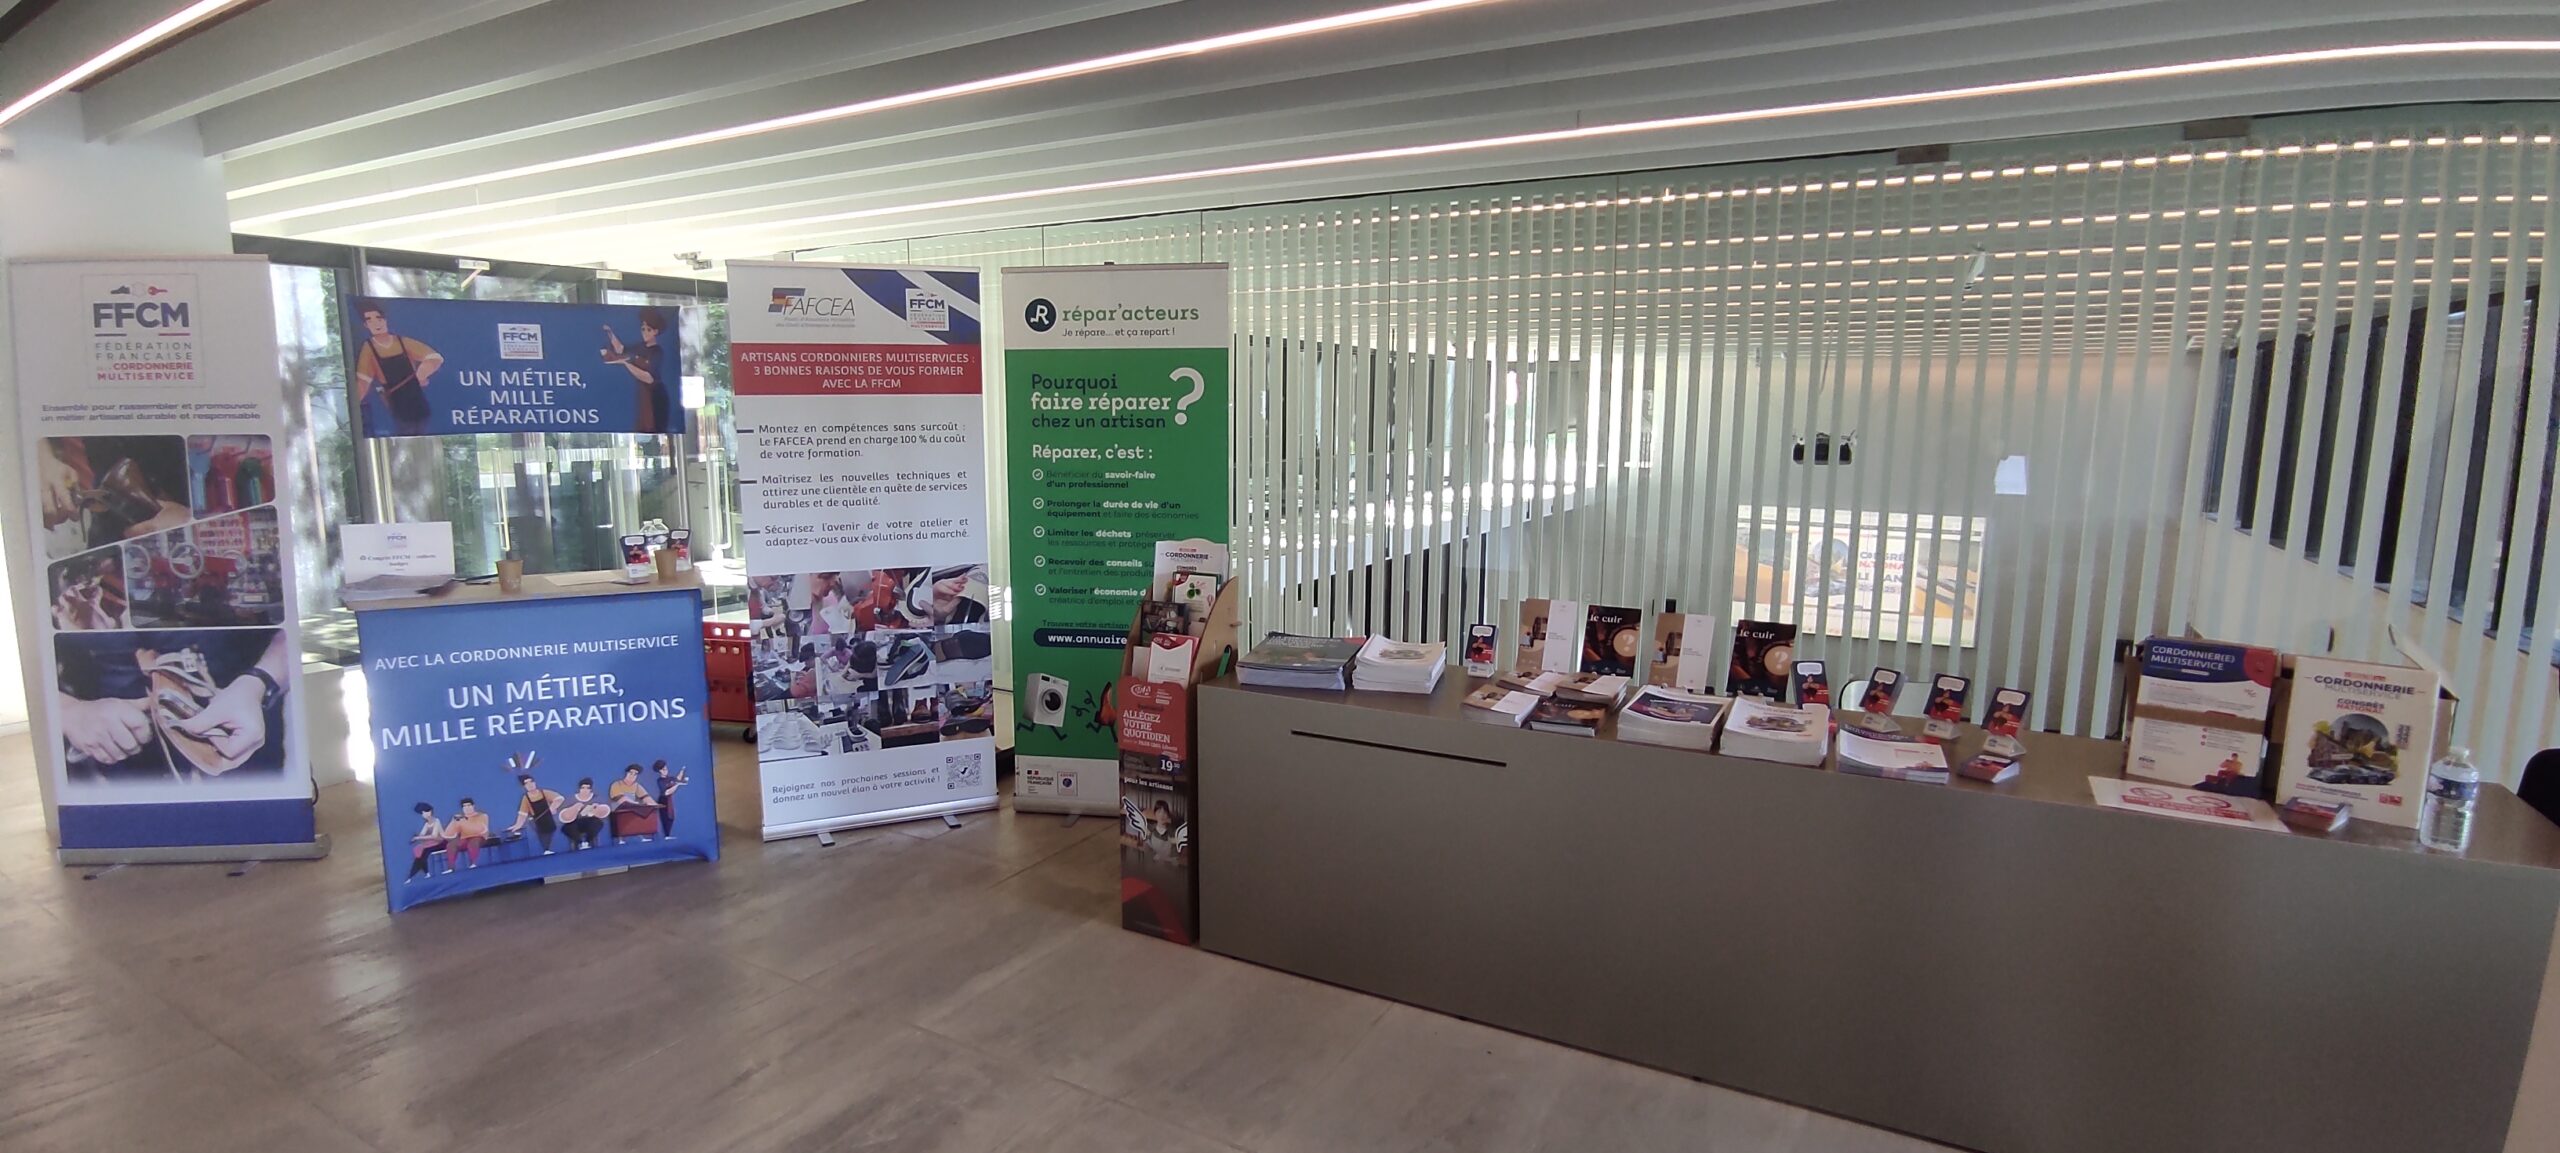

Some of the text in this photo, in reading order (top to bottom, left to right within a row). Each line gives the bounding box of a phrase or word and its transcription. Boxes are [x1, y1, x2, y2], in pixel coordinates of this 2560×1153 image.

[783, 297, 855, 317] FAFCEA
[909, 299, 945, 309] FFCM
[93, 303, 189, 328] FFCM
[1062, 304, 1199, 327] répar'acteurs
[503, 332, 538, 341] FFCM
[1075, 327, 1113, 338] répare...
[1115, 328, 1124, 336] et
[1127, 329, 1138, 338] ça
[1140, 328, 1169, 338] repart
[95, 342, 192, 350] FÉDÉRATION
[96, 352, 193, 360] FRANÇAISE
[741, 353, 969, 363] ARTISANS CORDONNIERS MULTISERVICES
[113, 362, 193, 370] CORDONNERIE
[754, 366, 963, 376] 3 BONNES RAISONS DE VOUS FORMER
[97, 372, 194, 380] MULTISERVICE
[459, 368, 587, 389] UN MÉTIER,
[823, 379, 901, 388] AVEC LA FFCM
[1032, 373, 1118, 394] Pourquoi
[491, 390, 554, 406] MILLE
[1031, 367, 1204, 425] faire réparer ?
[92, 404, 115, 412] pour
[195, 403, 257, 411] promouvoir
[57, 413, 85, 421] métier
[137, 412, 176, 420] durable
[193, 412, 260, 421] responsable
[452, 406, 600, 425] RÉPARATIONS
[1032, 414, 1166, 428] chez un artisan
[759, 424, 798, 434] Montez
[822, 423, 888, 434] compétences
[921, 422, 958, 431] surcoût
[760, 434, 966, 448] Le FAFCEA prend en charge 100 % du coût
[760, 448, 863, 460] de votre formation.
[1032, 443, 1144, 463] Réparer, c'est
[762, 471, 967, 484] Maîtrisez les nouvelles techniques et
[1105, 471, 1156, 479] savoir-faire
[763, 488, 799, 497] attirez
[823, 484, 867, 495] clientèle
[884, 482, 912, 495] quête
[915, 483, 926, 492] de
[929, 482, 967, 491] services
[1046, 480, 1129, 489] d'un professionnel
[763, 497, 880, 510] durables et de qualité.
[1047, 500, 1181, 509] Prolonger la durée de vie d'un
[1047, 510, 1101, 519] équipement
[765, 518, 968, 534] Sécurisez l'avenir de votre atelier et
[766, 529, 969, 549] adaptez-vous aux évolutions du marché.
[1047, 529, 1079, 537] Limiter
[1081, 529, 1094, 537] les
[1048, 558, 1087, 566] Recevoir
[1106, 559, 1143, 567] conseils
[1049, 586, 1088, 594] Valoriser
[1602, 615, 1622, 624] cuir
[1753, 631, 1775, 640] cuir
[375, 635, 679, 671] AVEC LA CORDONNERIE MULTISERVICE
[2152, 645, 2236, 663] CORDONNIER(E)
[2151, 654, 2224, 671] MULTISERVICE
[2314, 675, 2415, 695] CORDONNERIE
[448, 673, 624, 710] UN MÉTIER,
[2336, 704, 2384, 714] NATIONAL
[2337, 698, 2384, 709] CONGRÈS
[1123, 710, 1161, 723] ALLÉGEZ
[382, 697, 686, 750] MILLE RÉPARATIONS
[1123, 719, 1152, 730] VOTRE
[1123, 728, 1170, 743] QUOTIDIEN
[772, 782, 815, 795] Rejoignez
[821, 780, 836, 788] nos
[841, 774, 888, 787] prochaines
[893, 769, 926, 779] sessions
[1149, 780, 1173, 791] artisans
[773, 793, 805, 804] donnez
[821, 788, 850, 798] nouvel
[852, 783, 870, 794] élan
[873, 782, 878, 792] à
[881, 781, 902, 790] votre
[905, 776, 936, 787] activité
